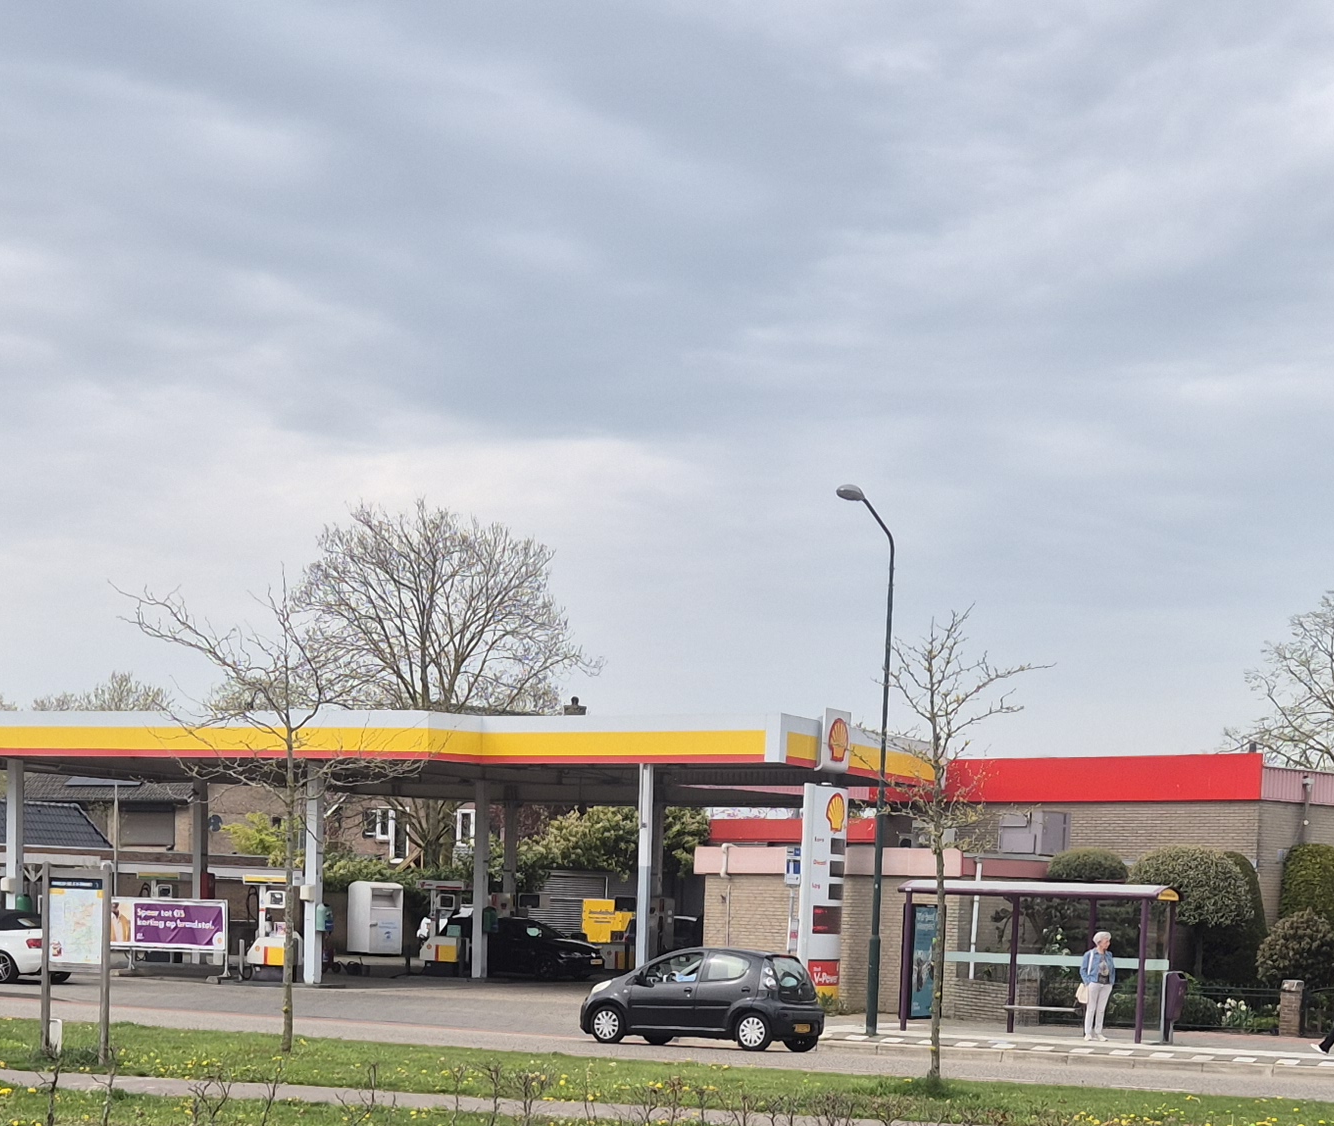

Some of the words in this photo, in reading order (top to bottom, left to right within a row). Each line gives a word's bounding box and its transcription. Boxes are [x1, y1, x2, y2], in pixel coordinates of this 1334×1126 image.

[137, 908, 159, 918] Spaar
[160, 909, 172, 917] tot
[137, 917, 164, 928] korting
[166, 920, 176, 929] op
